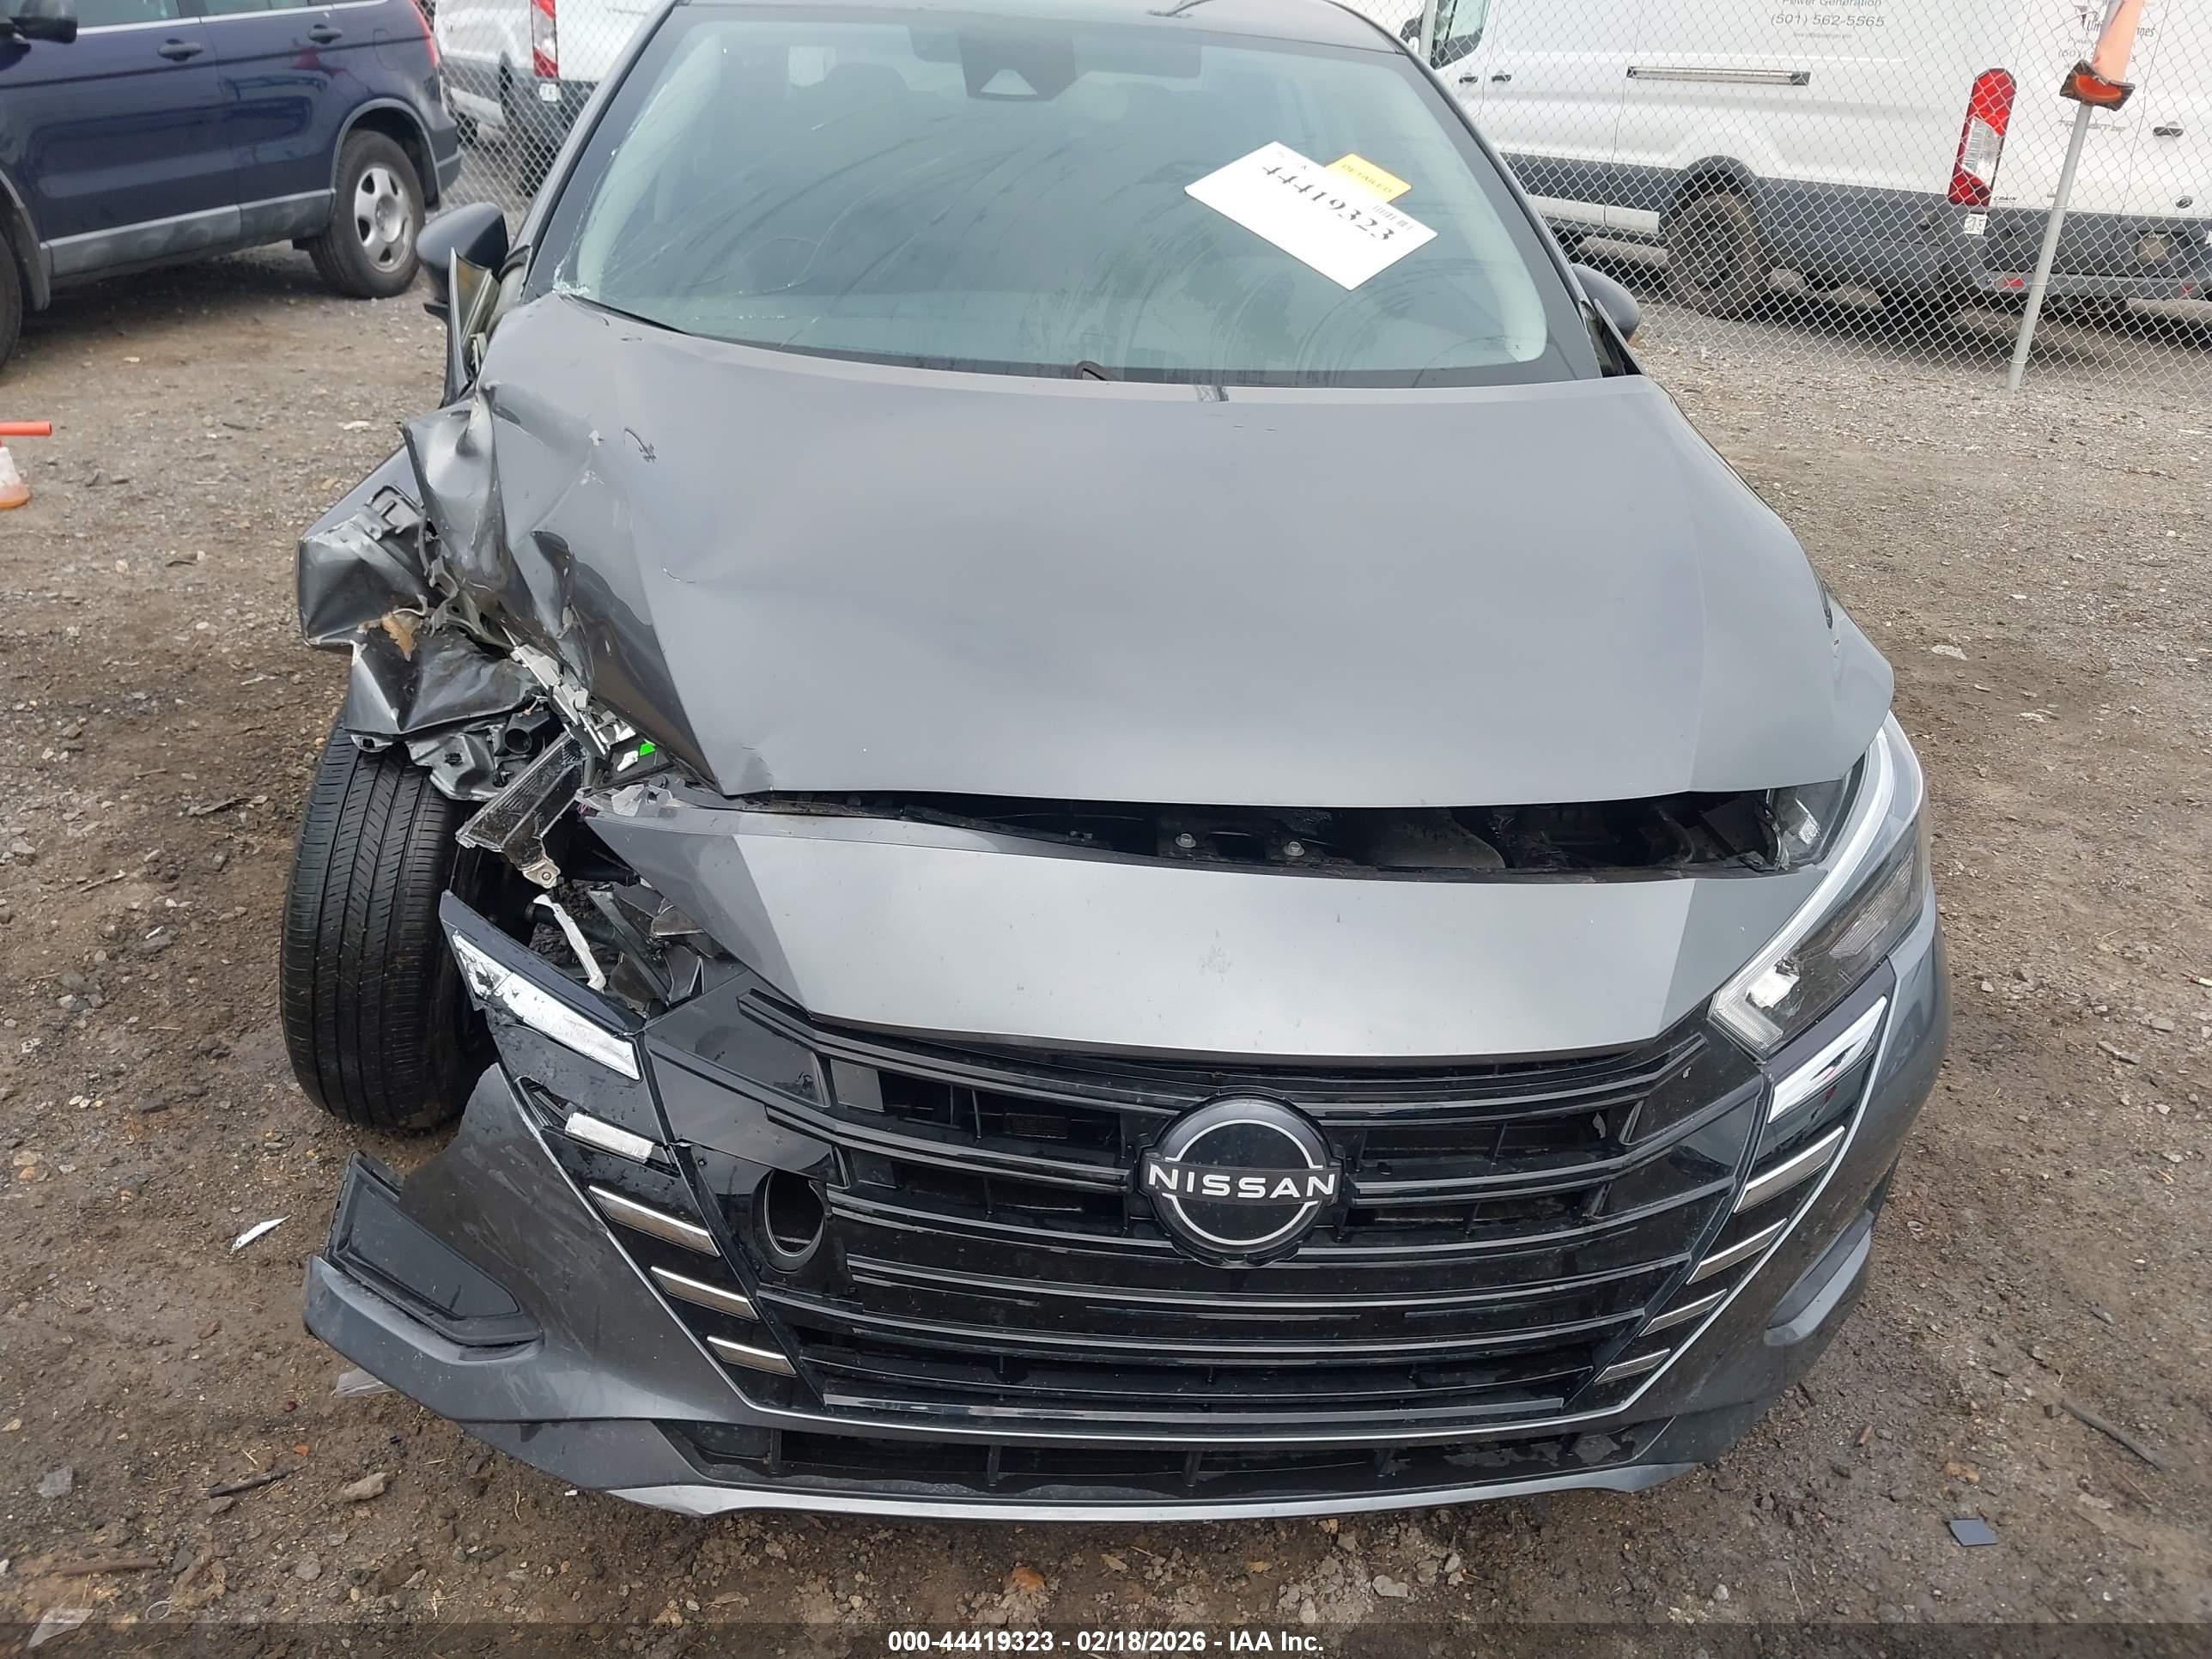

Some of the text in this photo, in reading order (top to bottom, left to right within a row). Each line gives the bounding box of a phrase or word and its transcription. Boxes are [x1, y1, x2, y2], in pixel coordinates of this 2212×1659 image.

[1771, 14, 1886, 27] (501) 562-5565
[1262, 167, 1395, 240] 44419323
[1148, 1162, 1335, 1199] NISSAN
